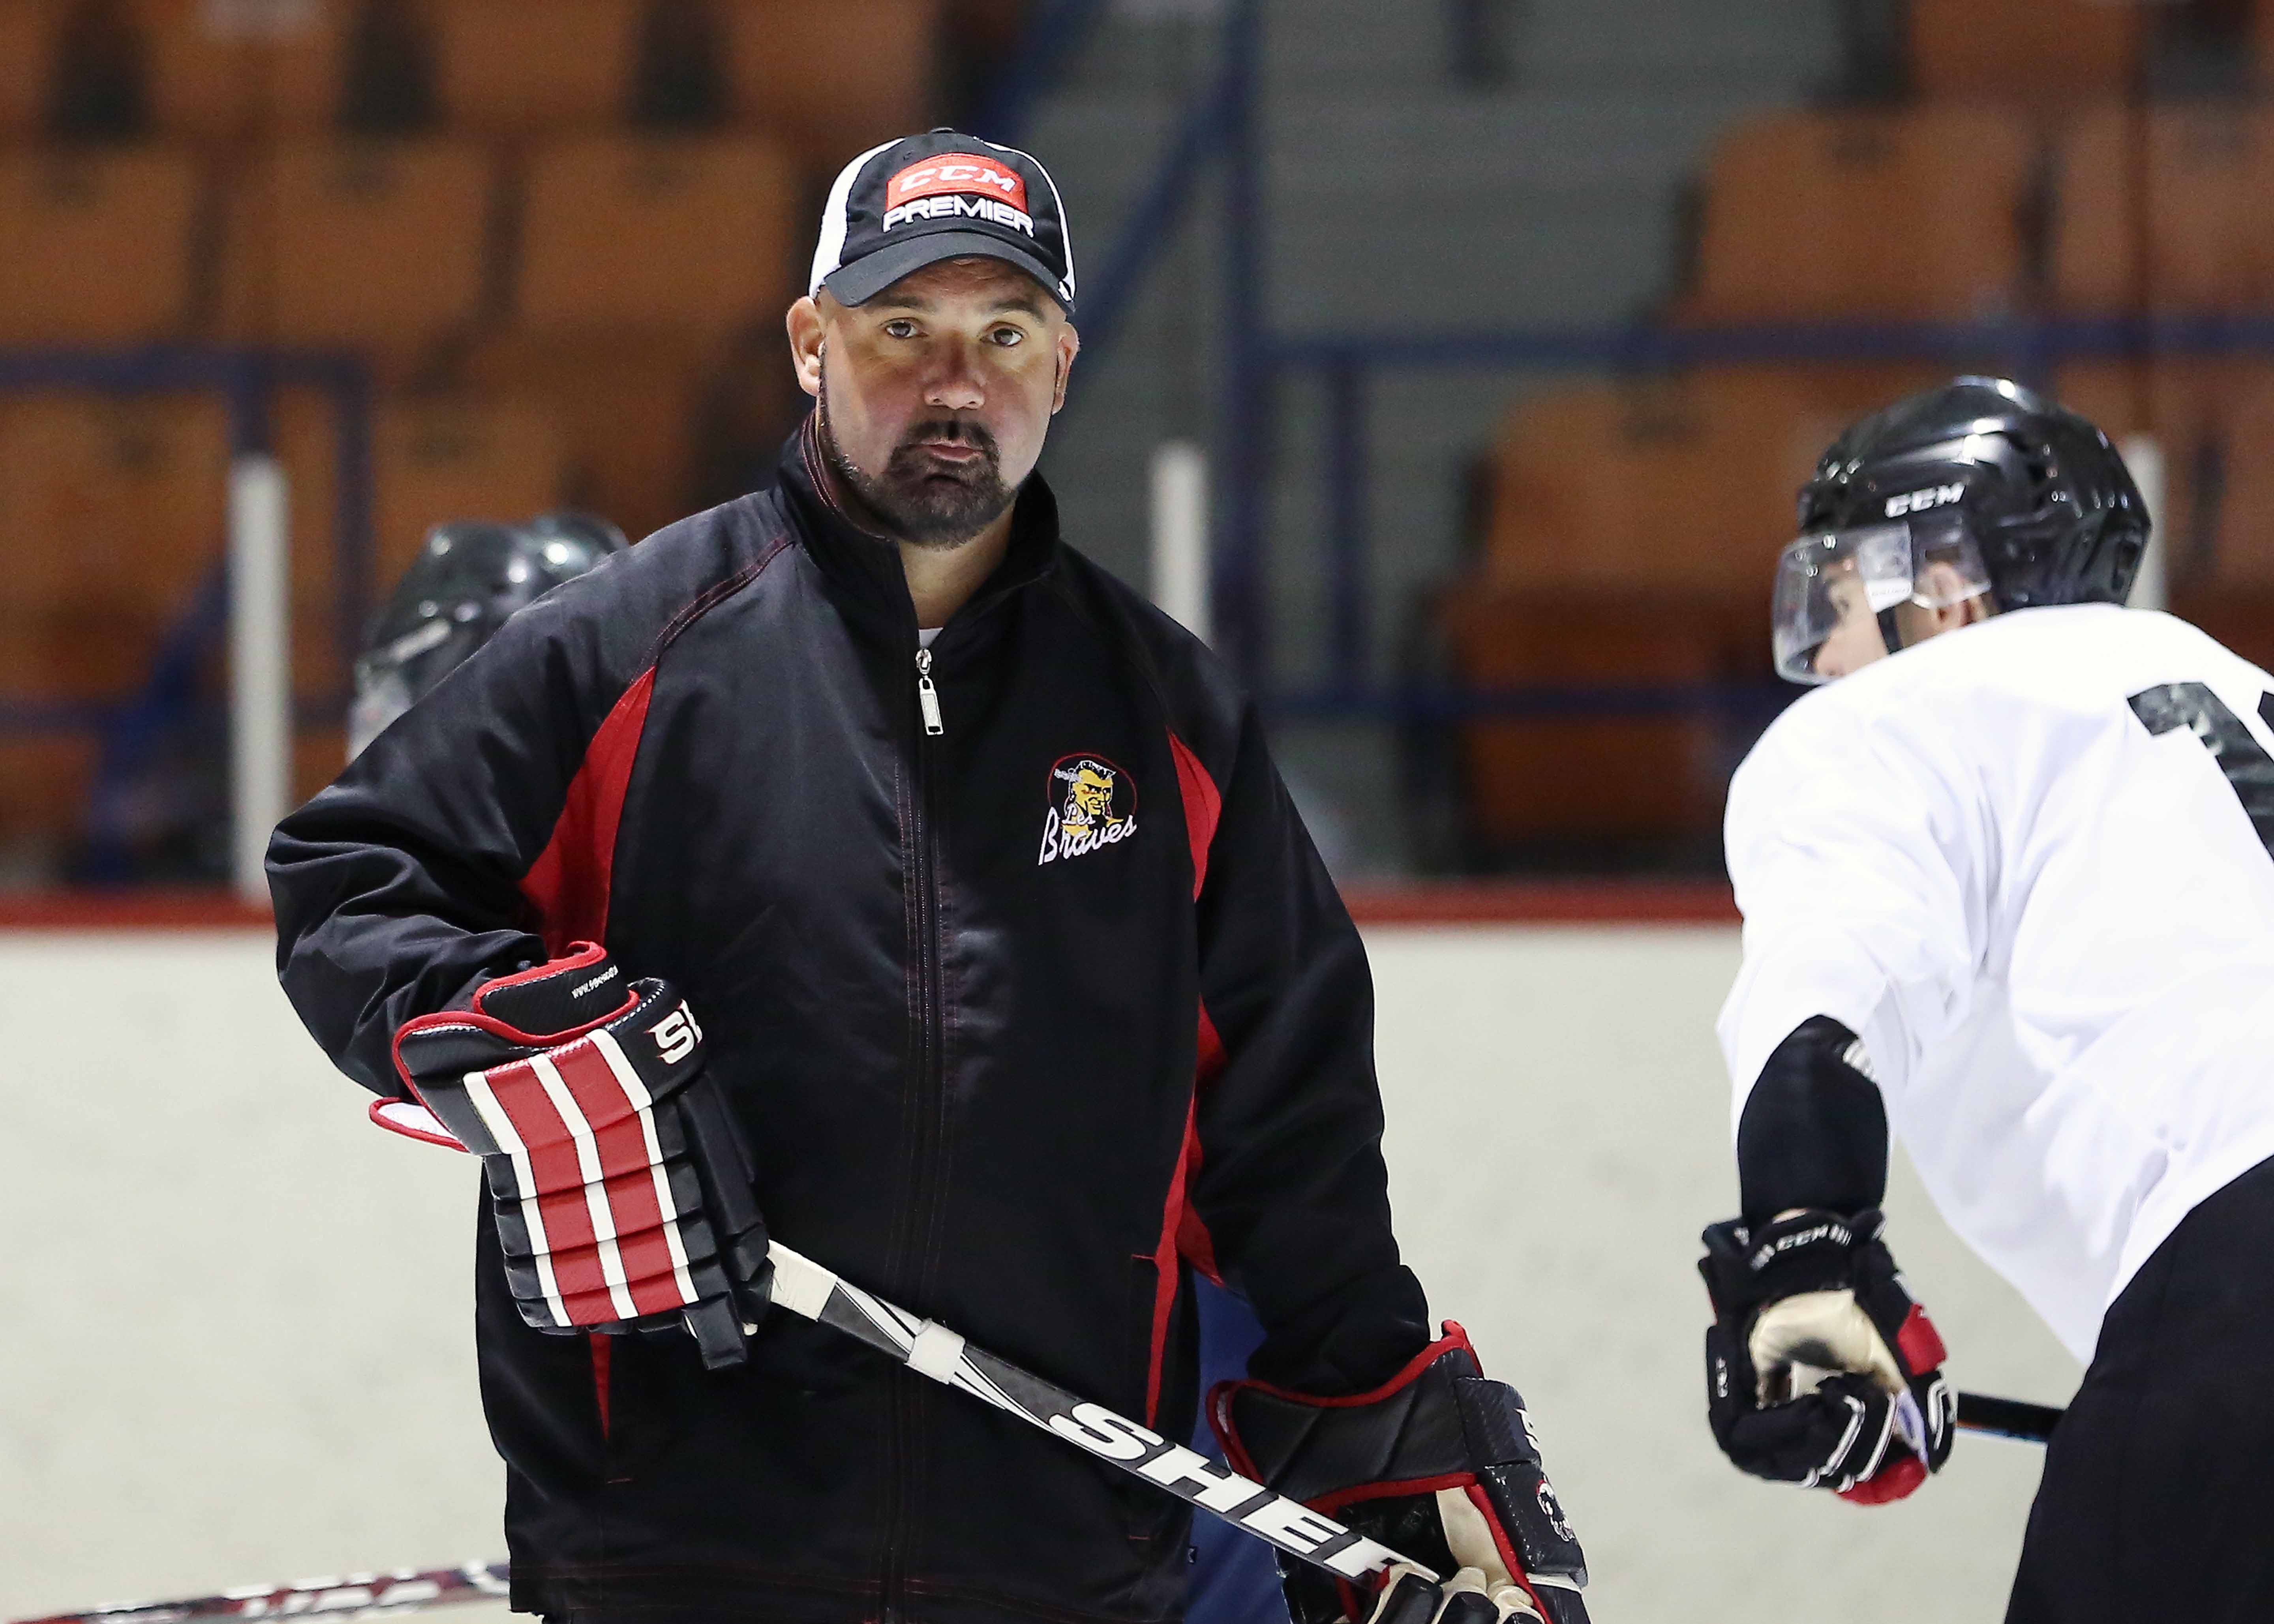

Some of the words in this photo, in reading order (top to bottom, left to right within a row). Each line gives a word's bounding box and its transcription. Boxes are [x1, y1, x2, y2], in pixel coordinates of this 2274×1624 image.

[900, 165, 1015, 193] CCM
[883, 195, 1034, 238] PREMIER
[1884, 480, 1965, 518] CCM
[1038, 806, 1137, 865] Braves
